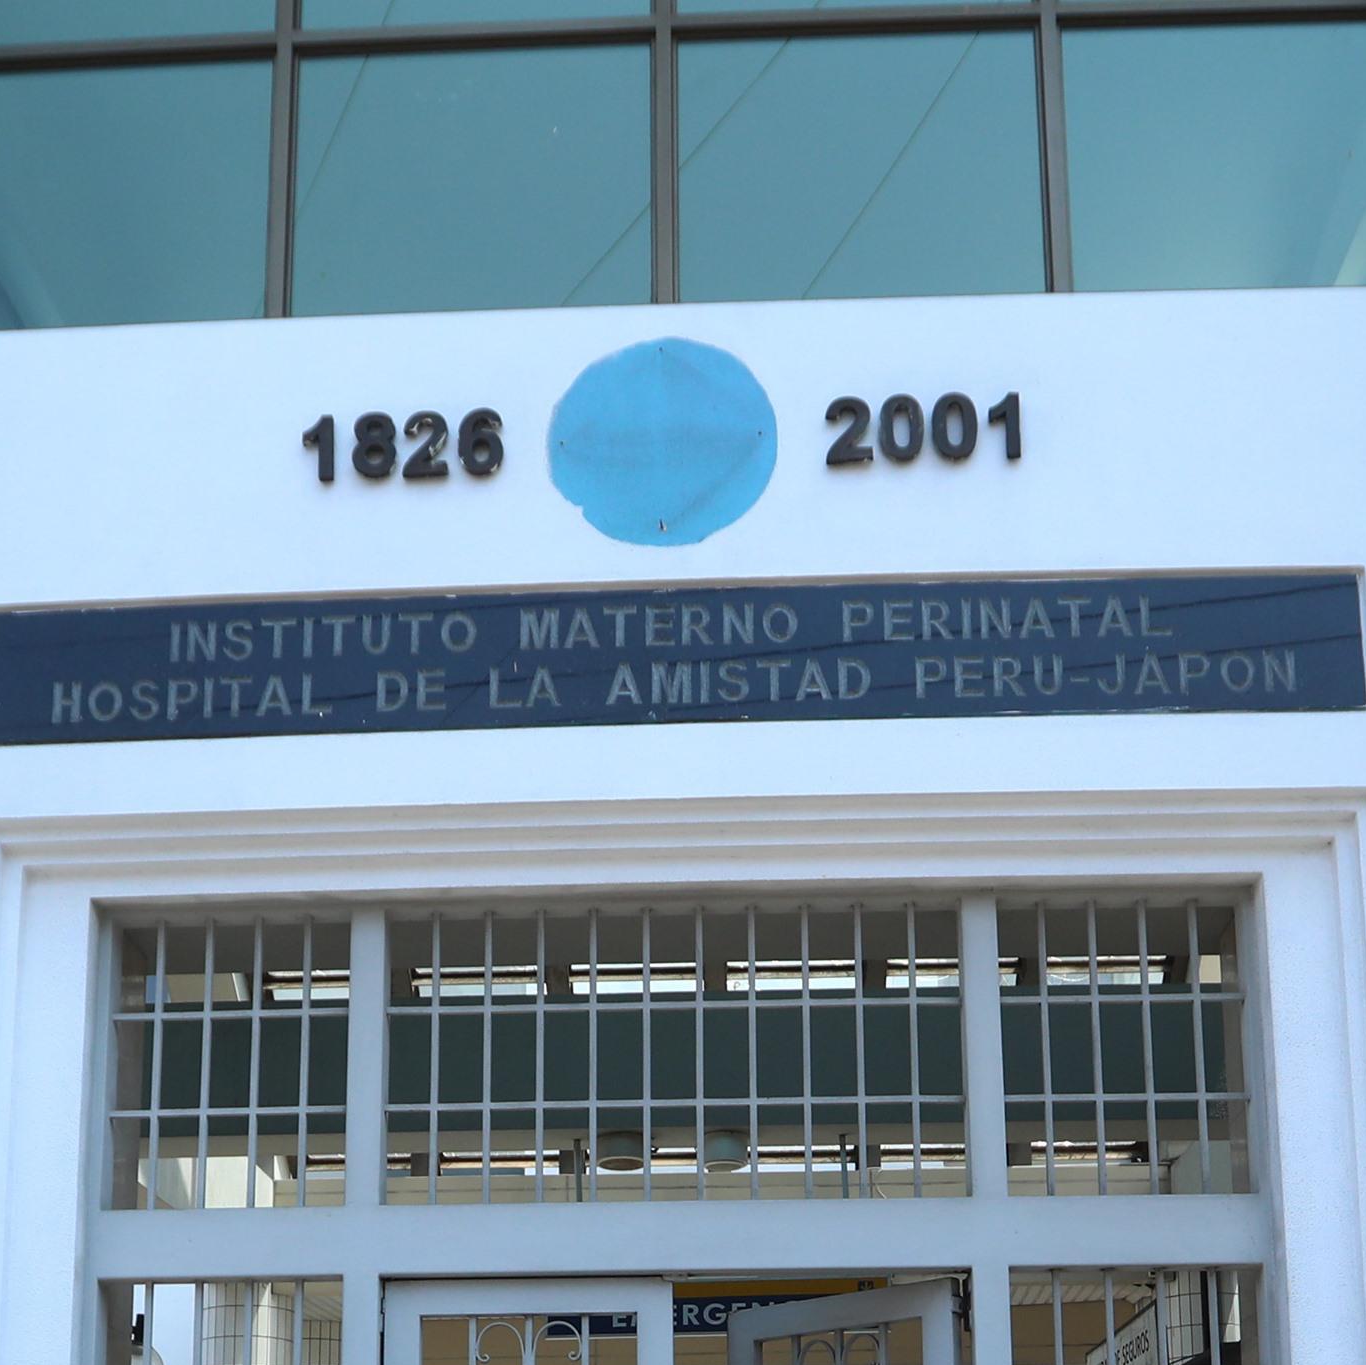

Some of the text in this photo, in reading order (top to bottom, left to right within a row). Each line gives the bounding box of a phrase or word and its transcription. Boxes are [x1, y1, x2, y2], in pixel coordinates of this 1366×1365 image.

[302, 407, 505, 482] 1826
[825, 391, 1022, 465] 2001
[168, 595, 1174, 664] INSTITUTO MATERNO PERINATAL
[50, 648, 1298, 725] HOSPITAL DE LA AMISTAD PERU-JAPON
